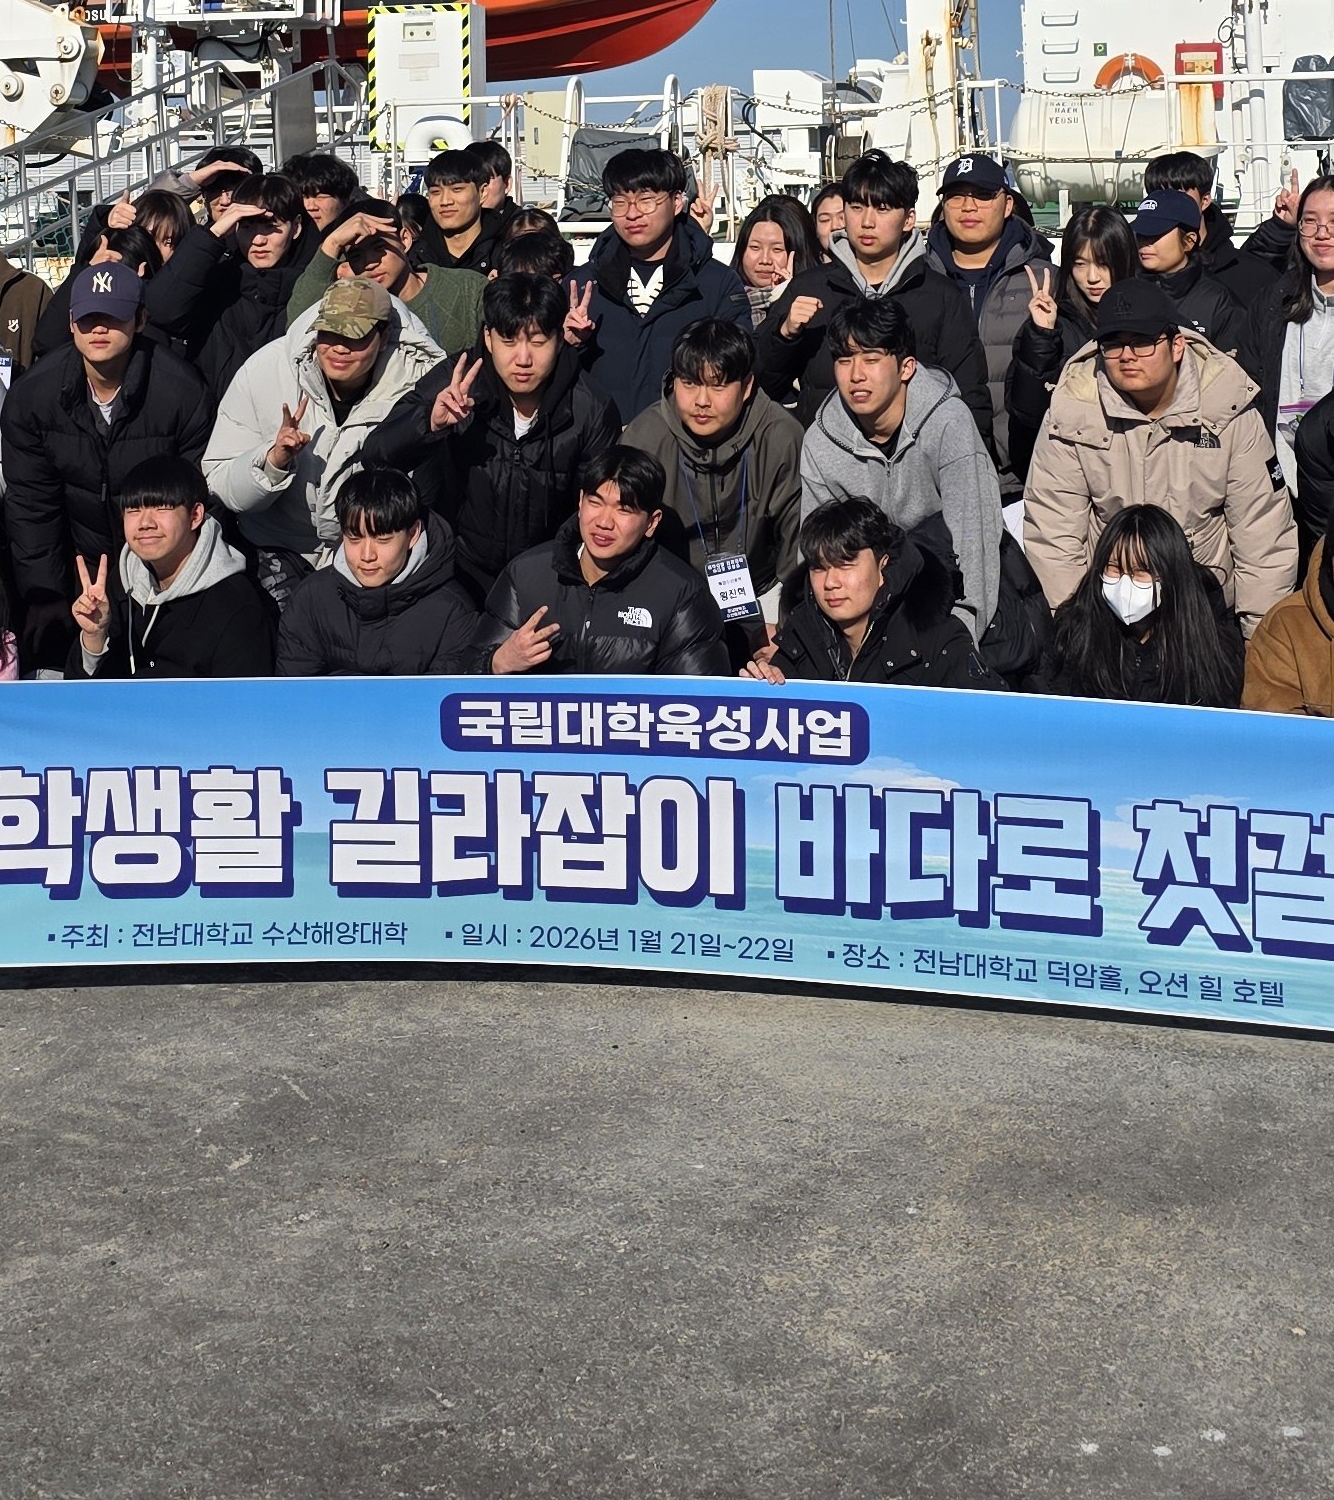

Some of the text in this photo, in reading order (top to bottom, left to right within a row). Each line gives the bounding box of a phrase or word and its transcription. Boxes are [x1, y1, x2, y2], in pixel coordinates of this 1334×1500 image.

[92, 271, 113, 293] NY
[457, 700, 852, 757] 국립대학육성사업
[322, 767, 741, 902] 길라잡이
[774, 782, 1099, 930] 바다로
[60, 923, 109, 949] 주최
[131, 922, 254, 947] 전남대학교
[261, 921, 408, 946] 수산해양대학
[460, 923, 508, 947] 일시
[529, 925, 620, 952] 2026년
[627, 928, 663, 954] 1월
[670, 931, 795, 963] 21일~22일
[841, 943, 891, 971] 장소
[913, 949, 1038, 984] 전남대학교
[1046, 959, 1130, 996] 덕암홀,
[1137, 969, 1189, 998] 오션
[1198, 974, 1223, 1004] 힐
[1232, 978, 1284, 1008] 호텔
